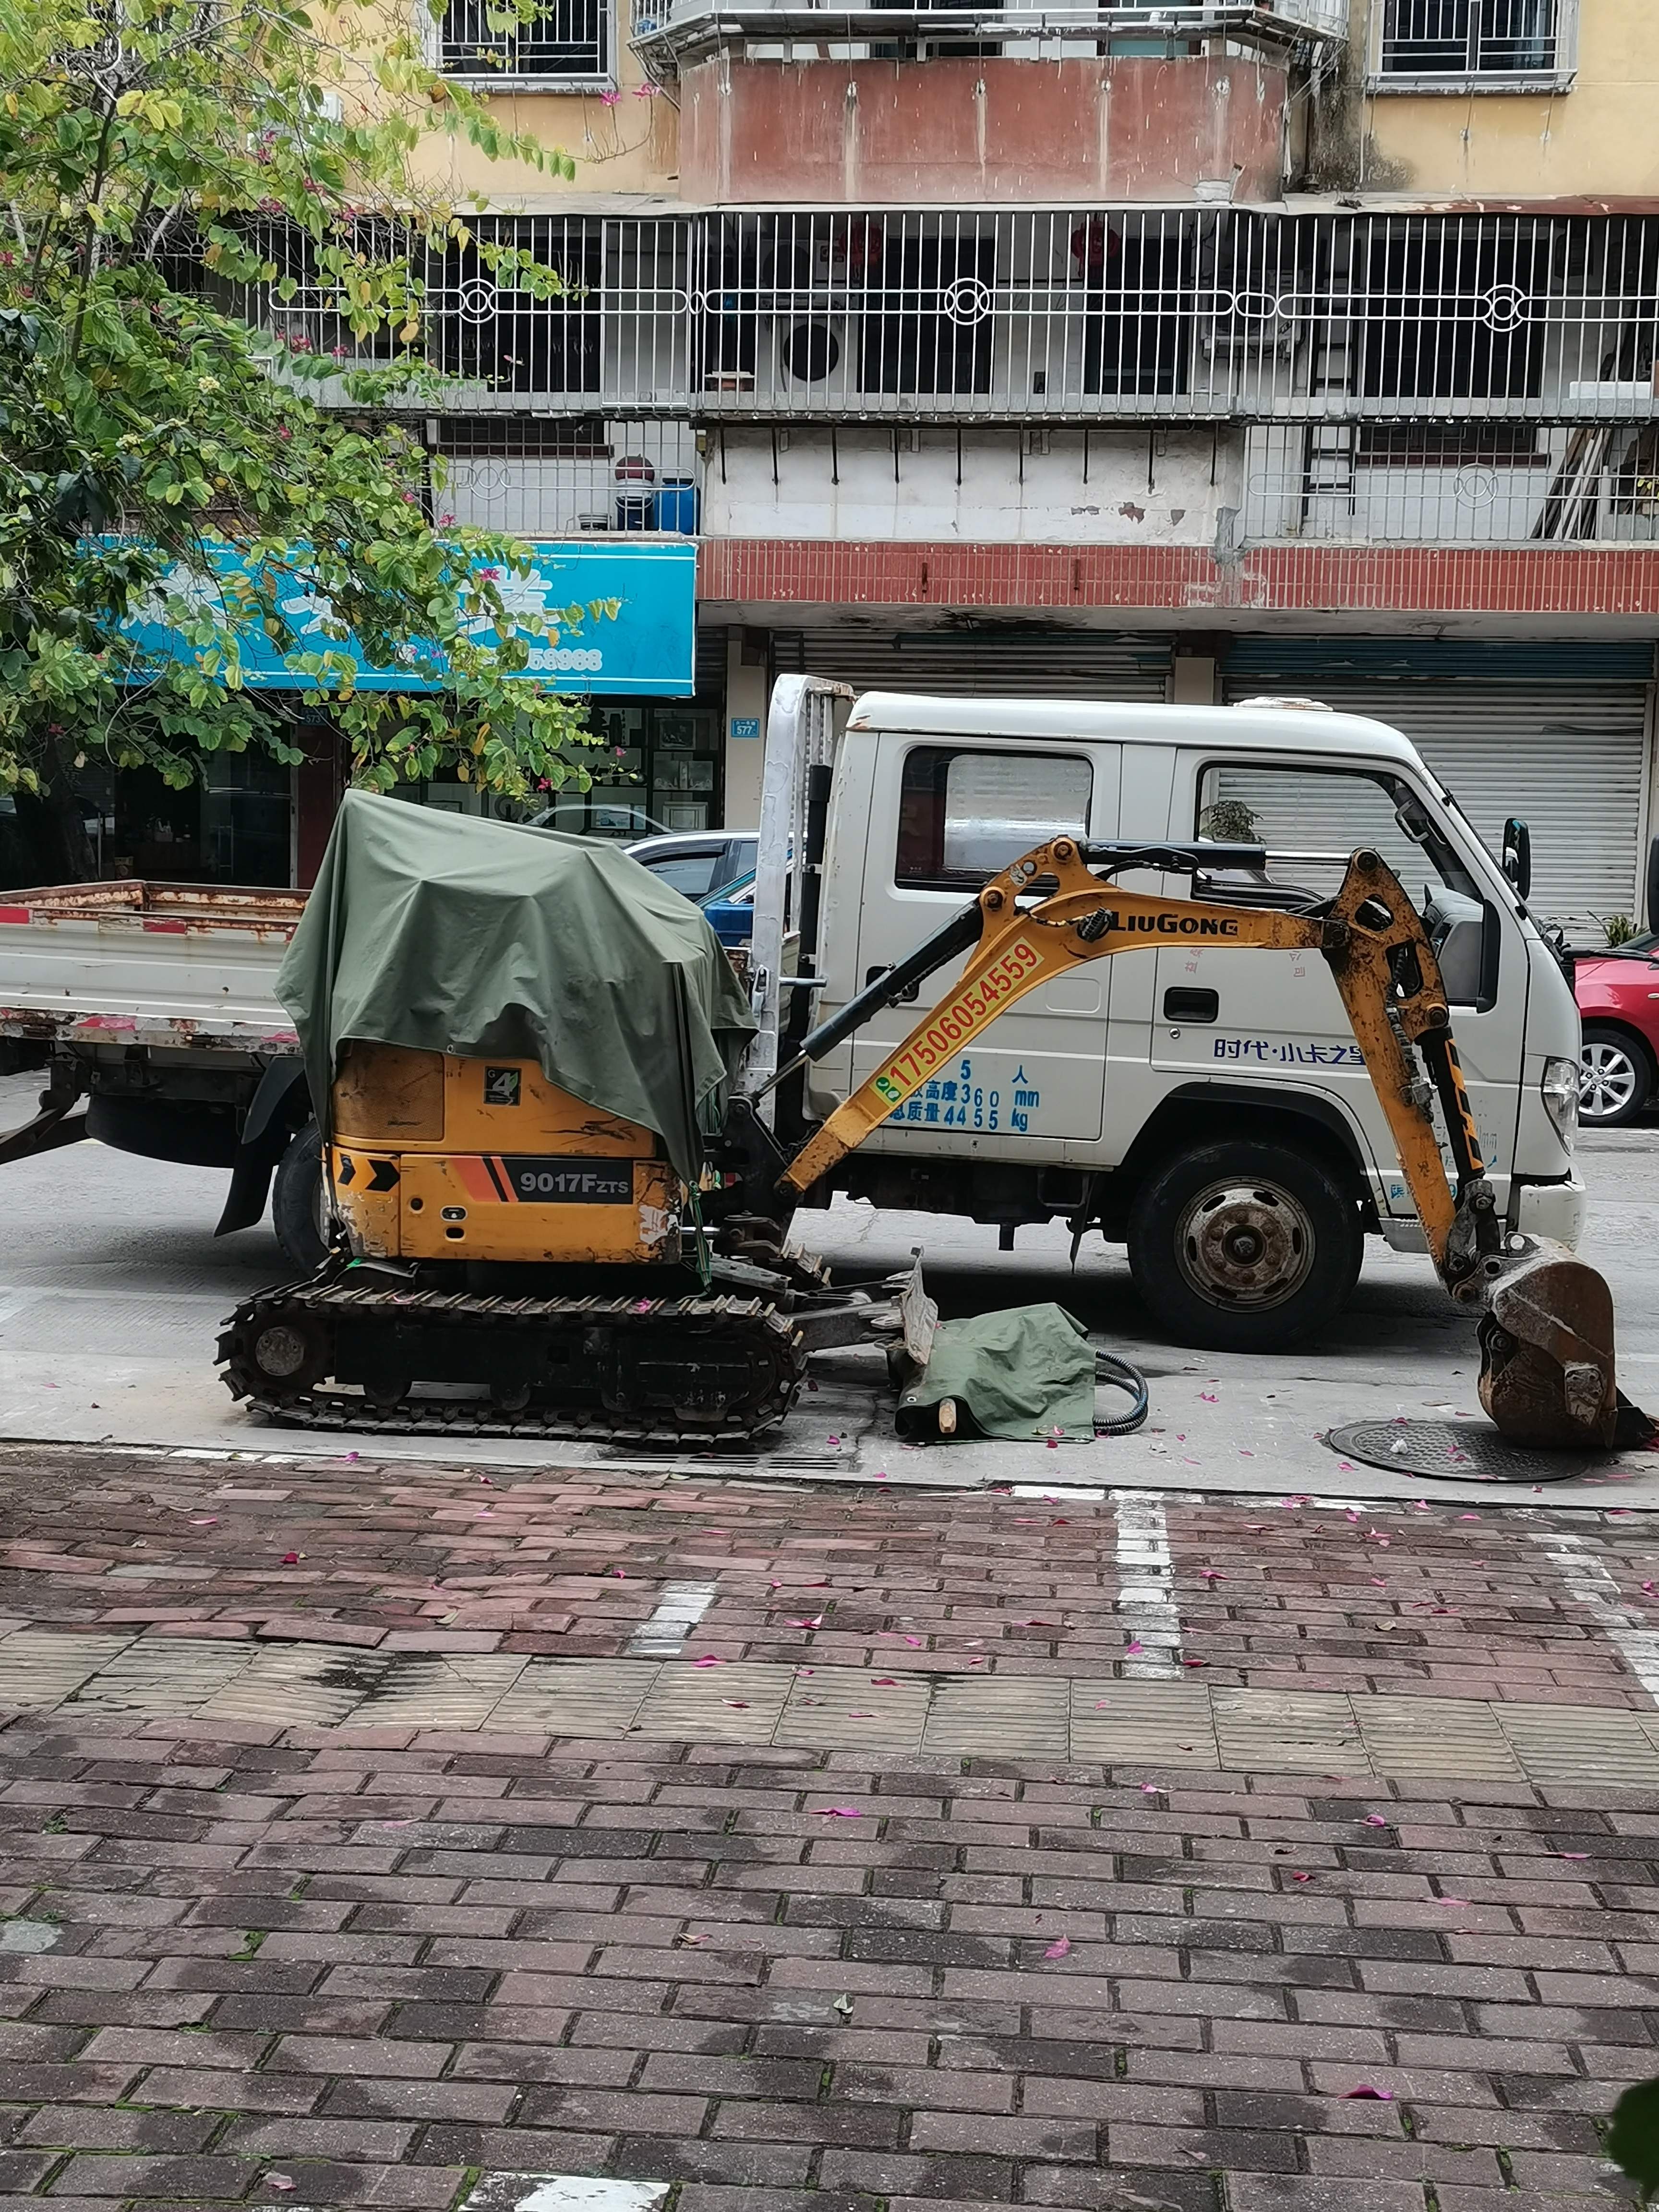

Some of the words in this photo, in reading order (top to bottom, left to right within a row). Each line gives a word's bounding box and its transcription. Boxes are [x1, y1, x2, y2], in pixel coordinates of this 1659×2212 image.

[737, 725, 752, 734] 577
[890, 944, 1037, 1086] 17506054559
[961, 1059, 971, 1080] 5
[1011, 1065, 1028, 1084] 人
[1015, 1090, 1039, 1107] mm
[1011, 1108, 1028, 1132] kg
